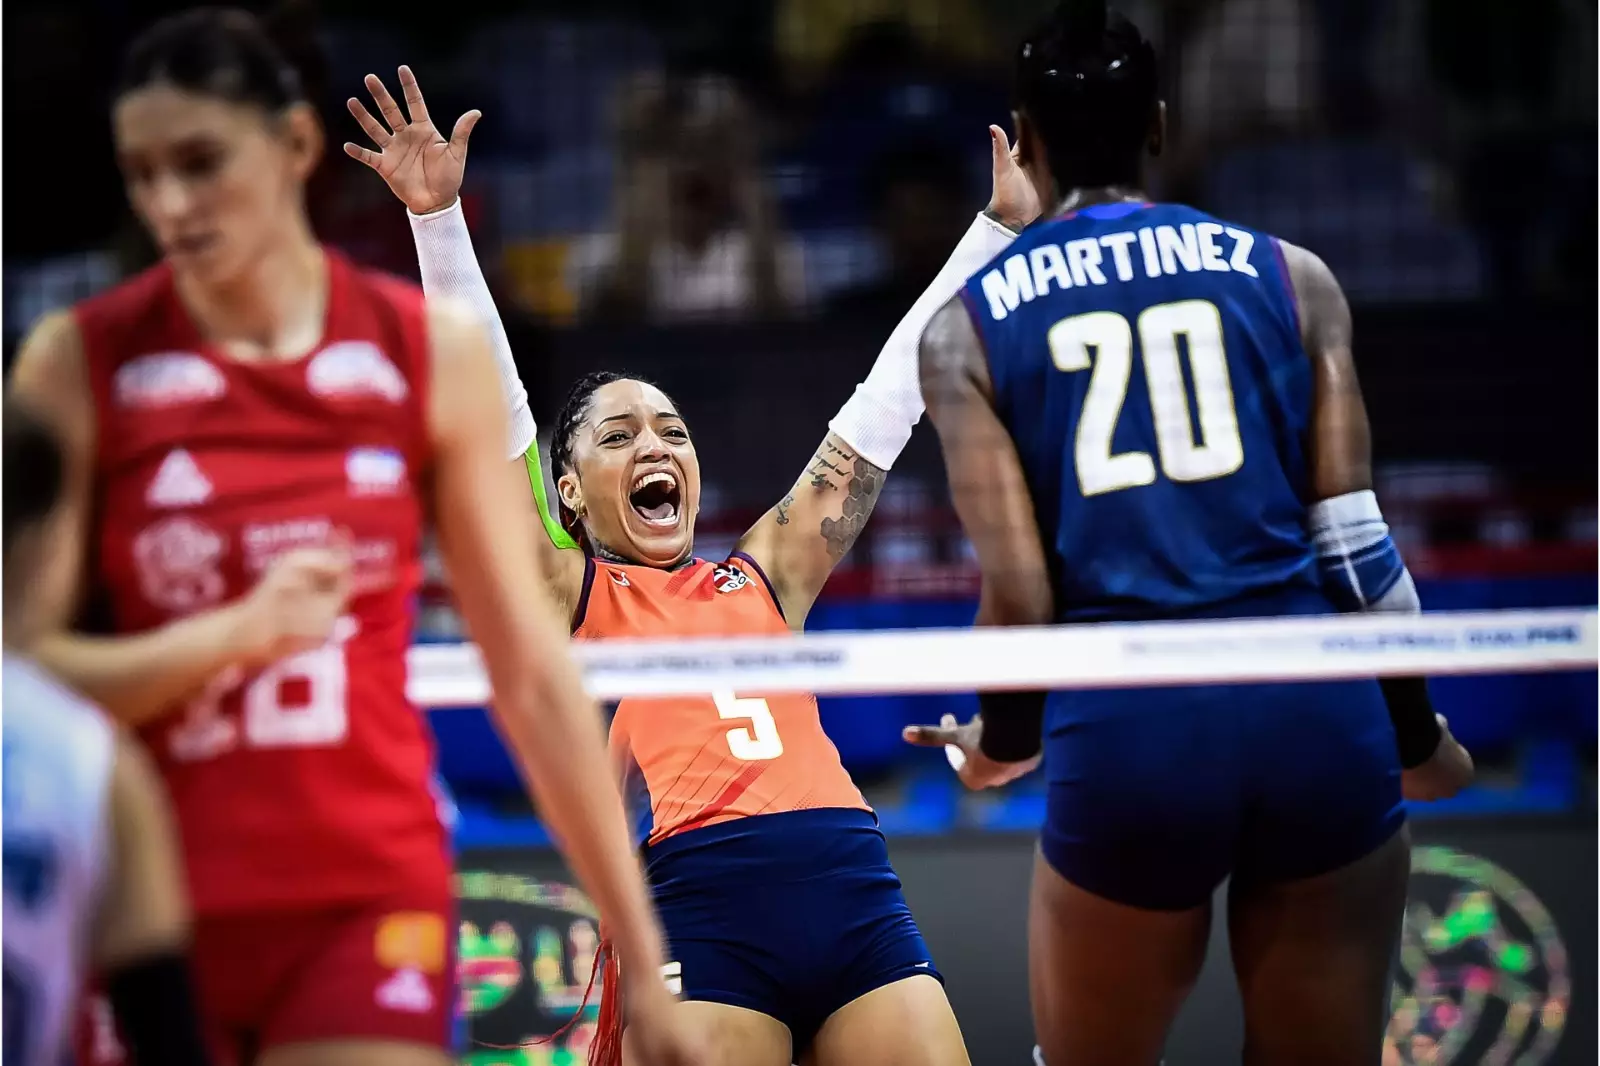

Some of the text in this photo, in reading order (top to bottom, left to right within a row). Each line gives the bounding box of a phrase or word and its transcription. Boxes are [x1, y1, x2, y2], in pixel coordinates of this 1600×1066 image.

[981, 222, 1258, 320] MARTINEZ
[1047, 299, 1244, 496] 20
[711, 690, 784, 760] 5
